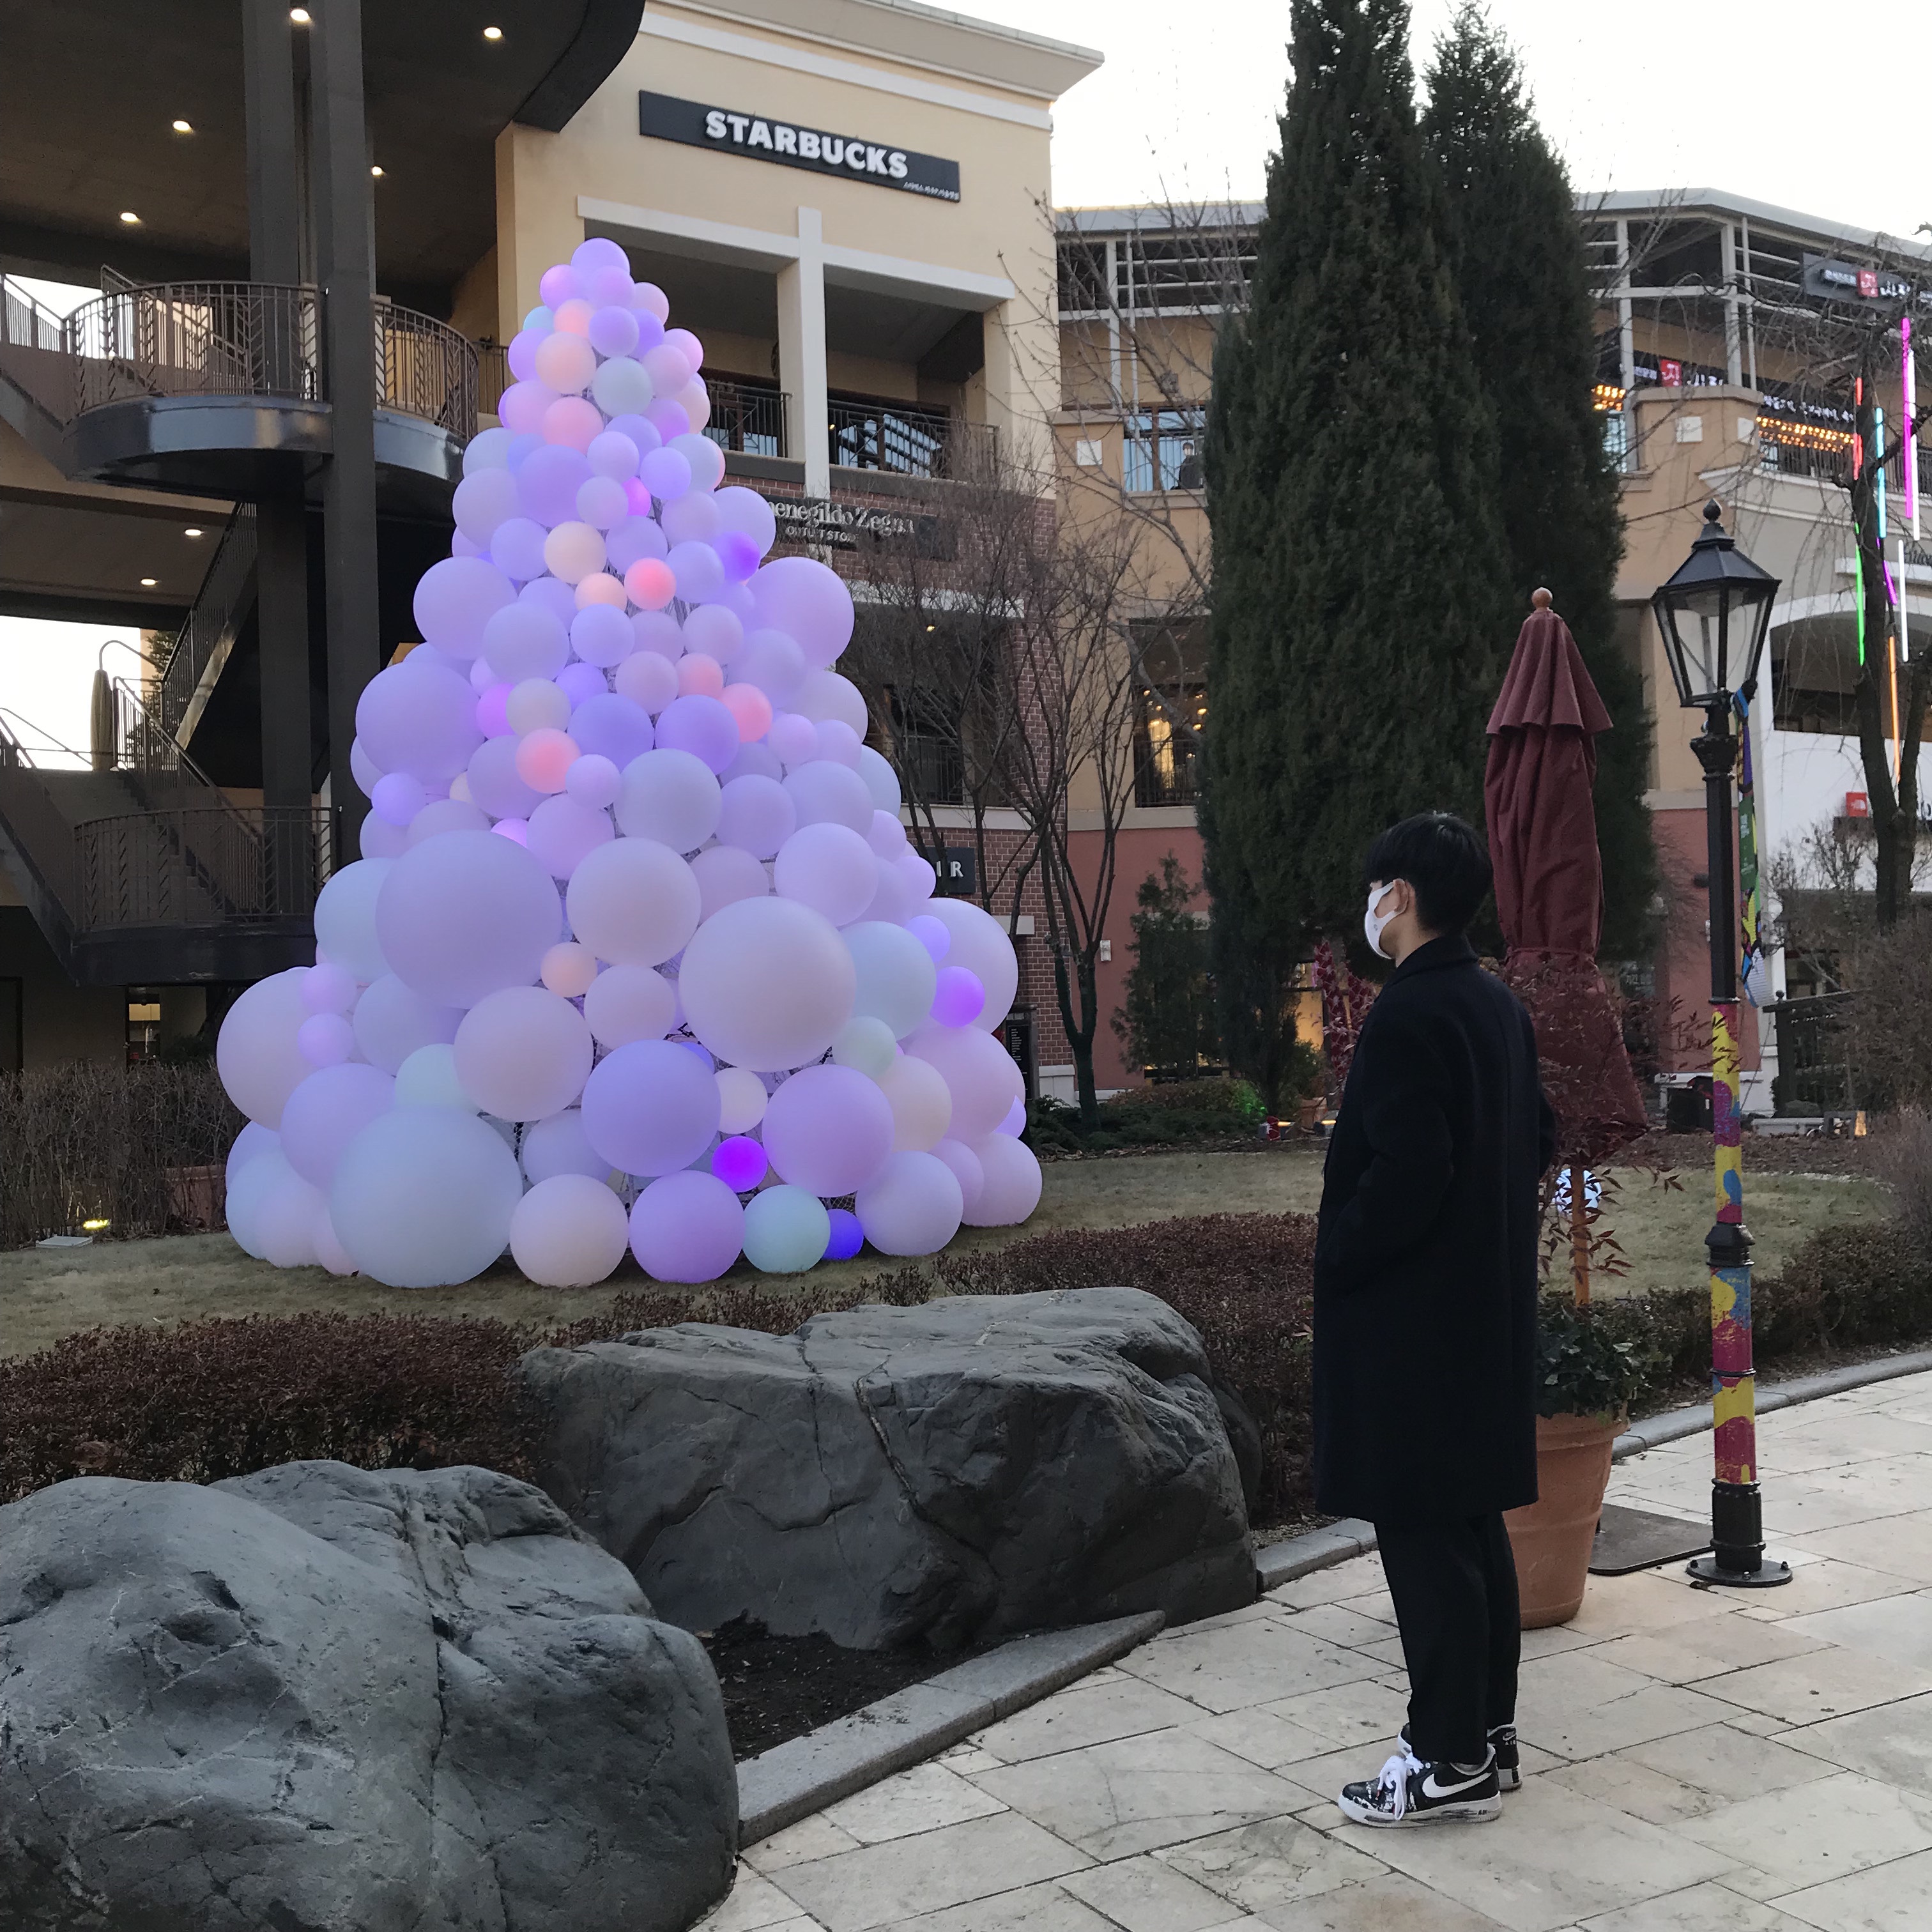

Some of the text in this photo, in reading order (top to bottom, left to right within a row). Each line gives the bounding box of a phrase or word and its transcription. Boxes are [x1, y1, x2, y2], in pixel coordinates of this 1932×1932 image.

[706, 111, 908, 178] STARBUCKS
[785, 525, 825, 539] OUTLT
[855, 507, 915, 537] Zegna
